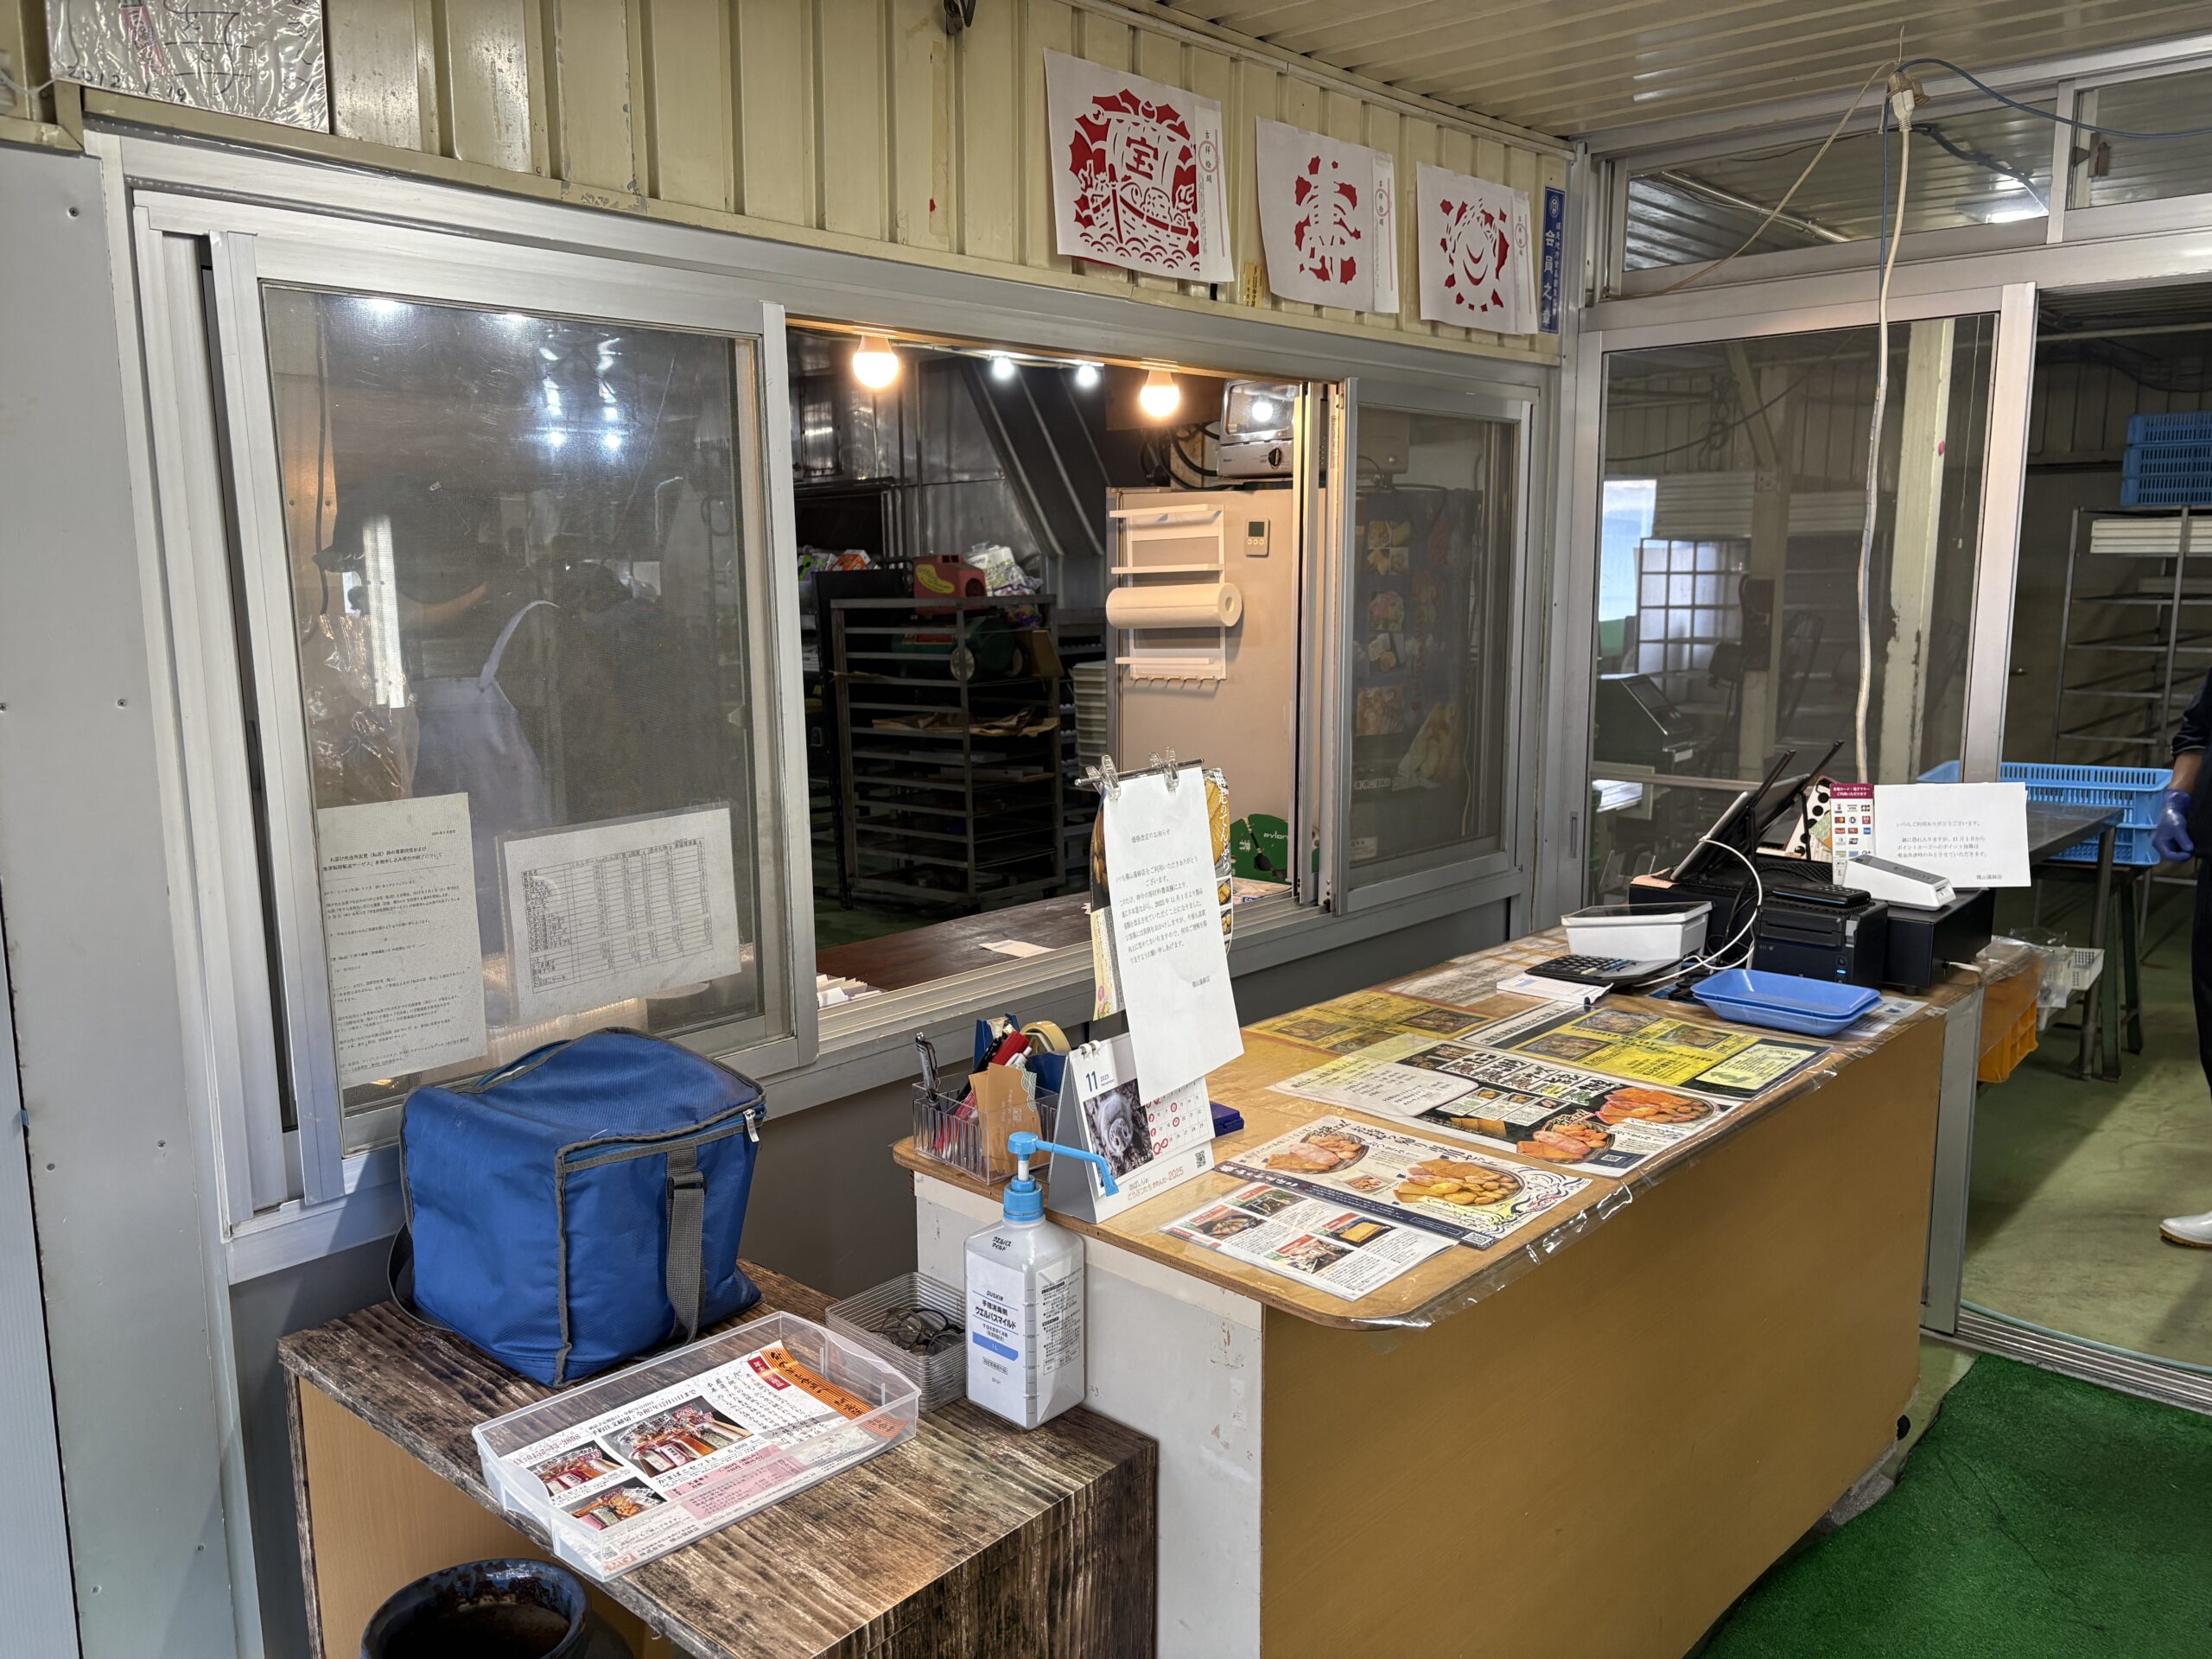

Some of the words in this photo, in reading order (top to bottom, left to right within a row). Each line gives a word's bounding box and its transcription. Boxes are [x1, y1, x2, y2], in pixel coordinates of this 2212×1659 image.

[1086, 1071, 1097, 1092] 11
[993, 1236, 1012, 1247] ウエルパス
[993, 1243, 1007, 1251] マイルド
[987, 1290, 1003, 1301] DUSKIN
[982, 1300, 1007, 1316] 手指消毒剤
[976, 1306, 1016, 1329] ウエルパスマイルド
